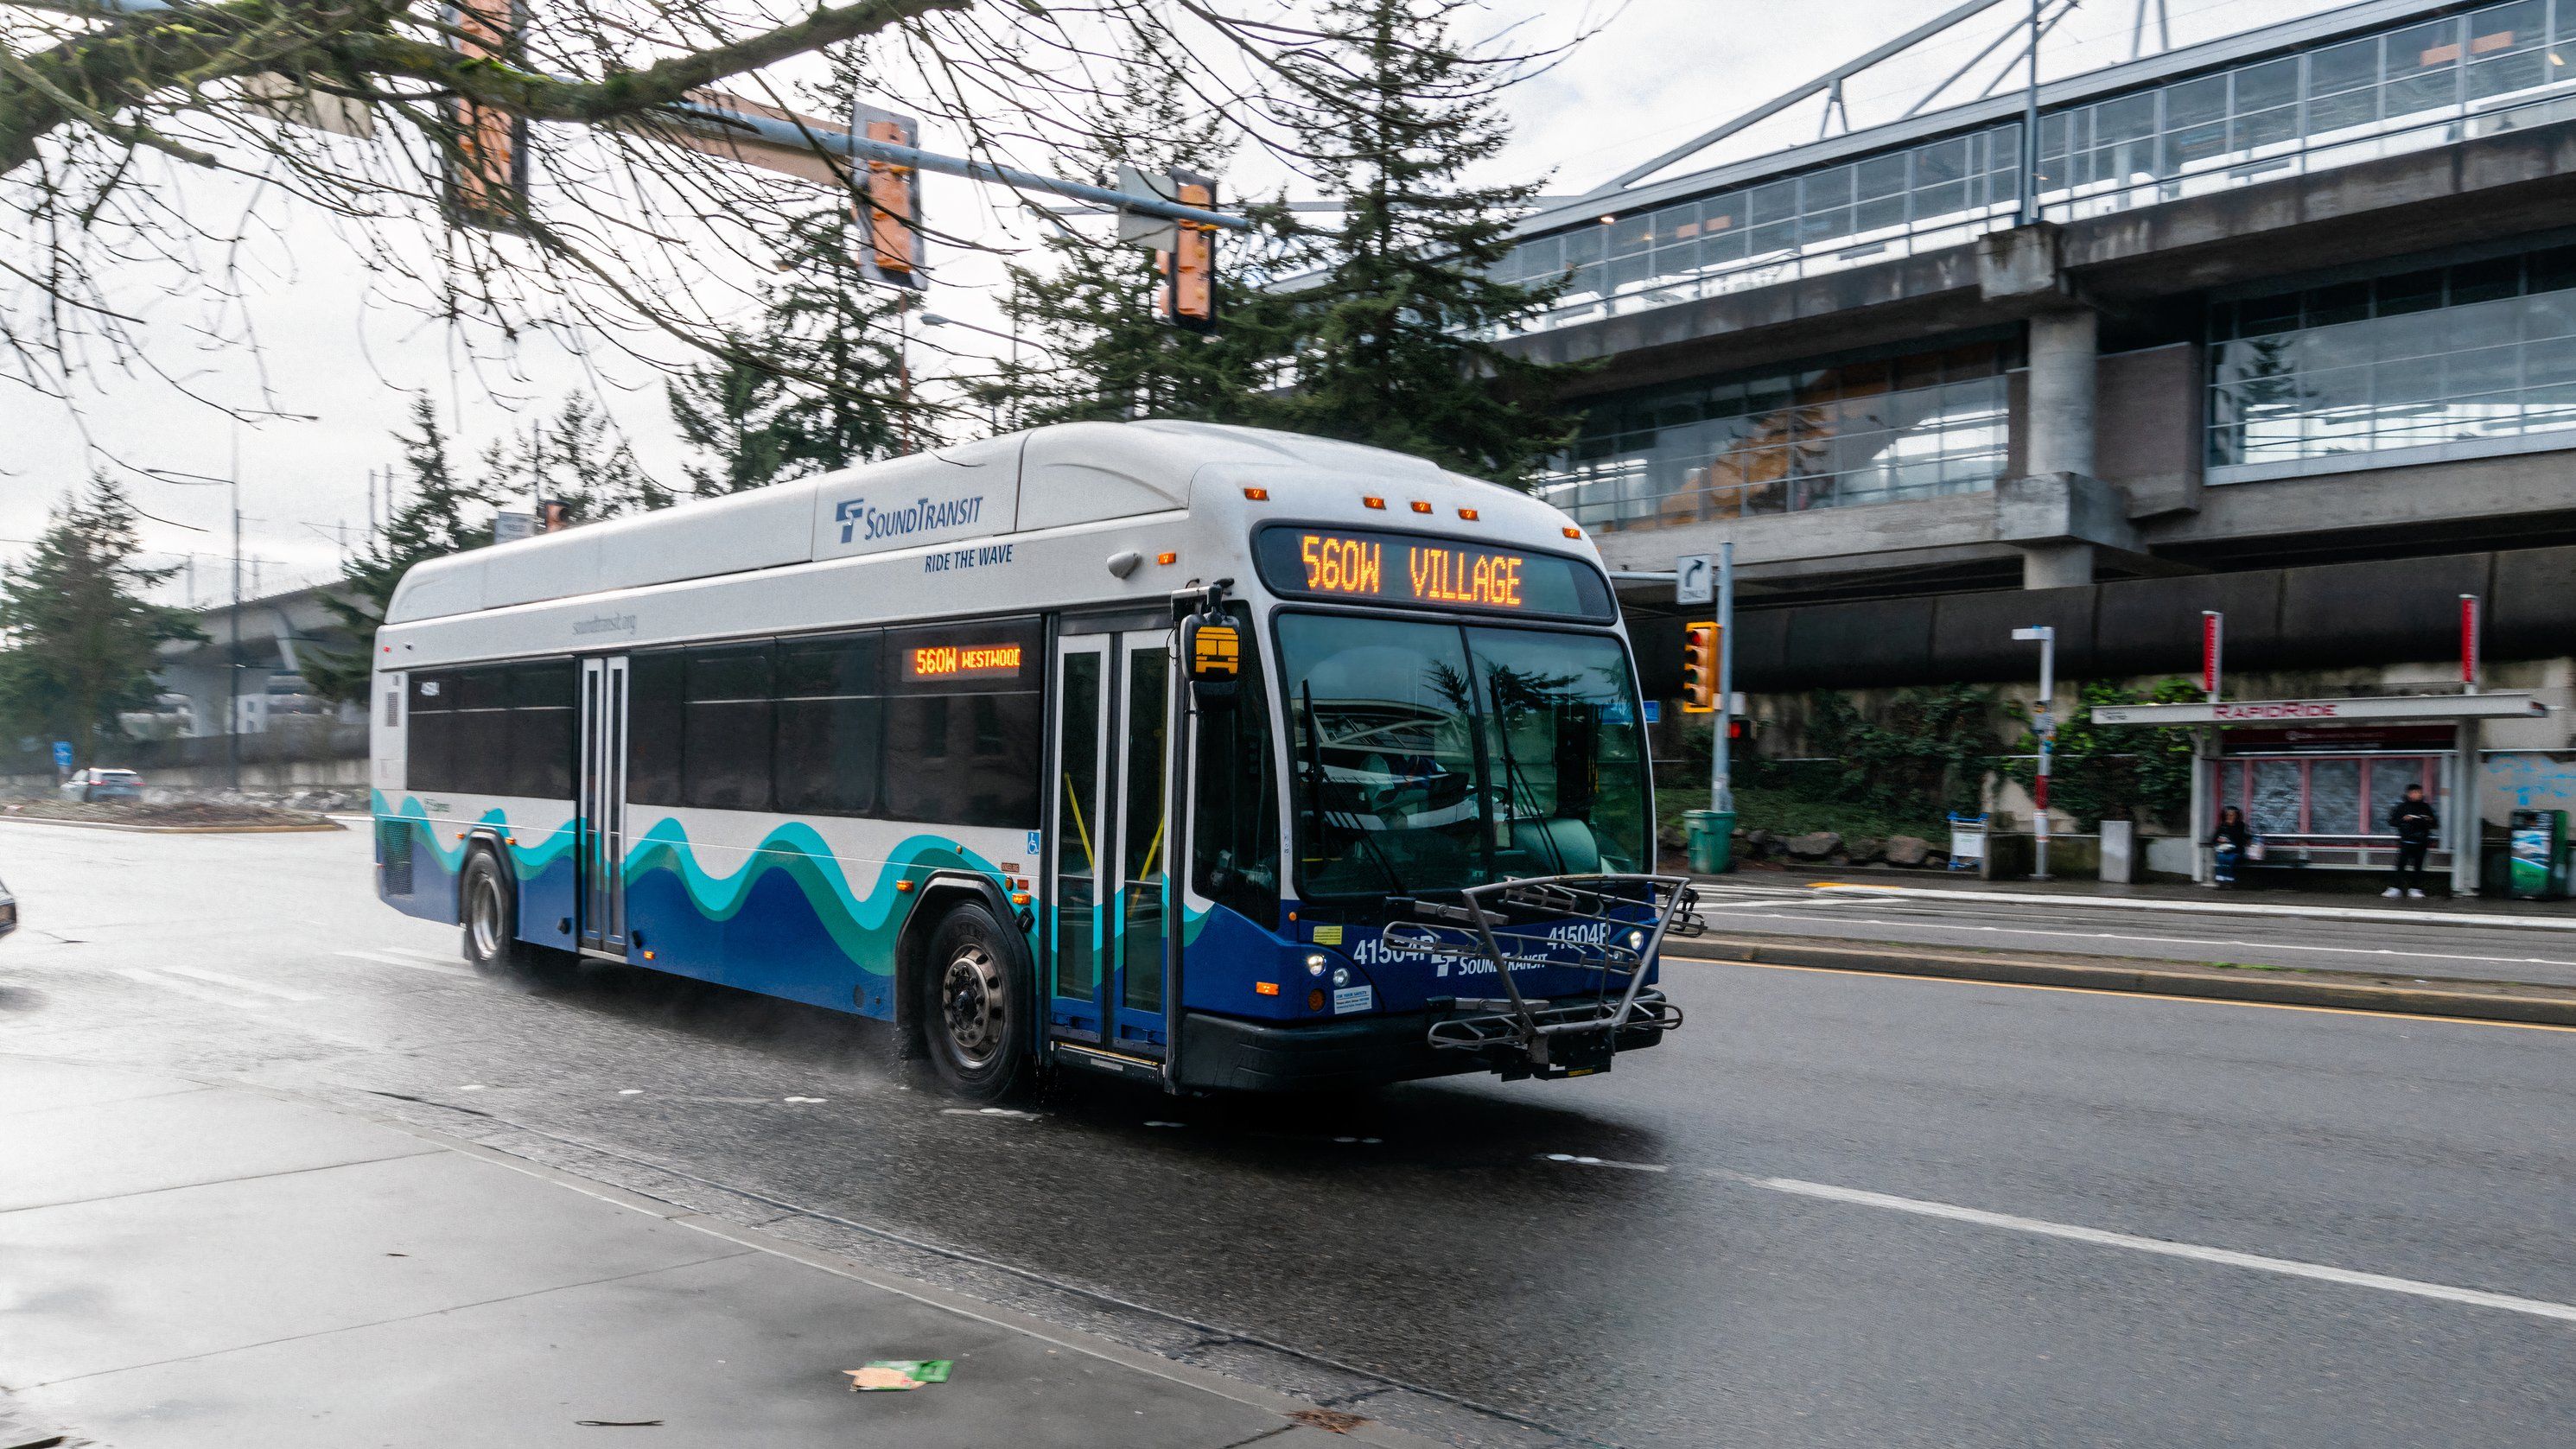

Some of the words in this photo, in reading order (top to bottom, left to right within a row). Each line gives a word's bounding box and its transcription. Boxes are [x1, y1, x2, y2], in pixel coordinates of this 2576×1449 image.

[925, 553, 951, 573] RIDE
[954, 550, 975, 569] THE
[979, 544, 1014, 565] WAVE
[1302, 535, 1380, 594] 560W
[1409, 546, 1523, 606] VILLAGE
[916, 648, 957, 674] 560W
